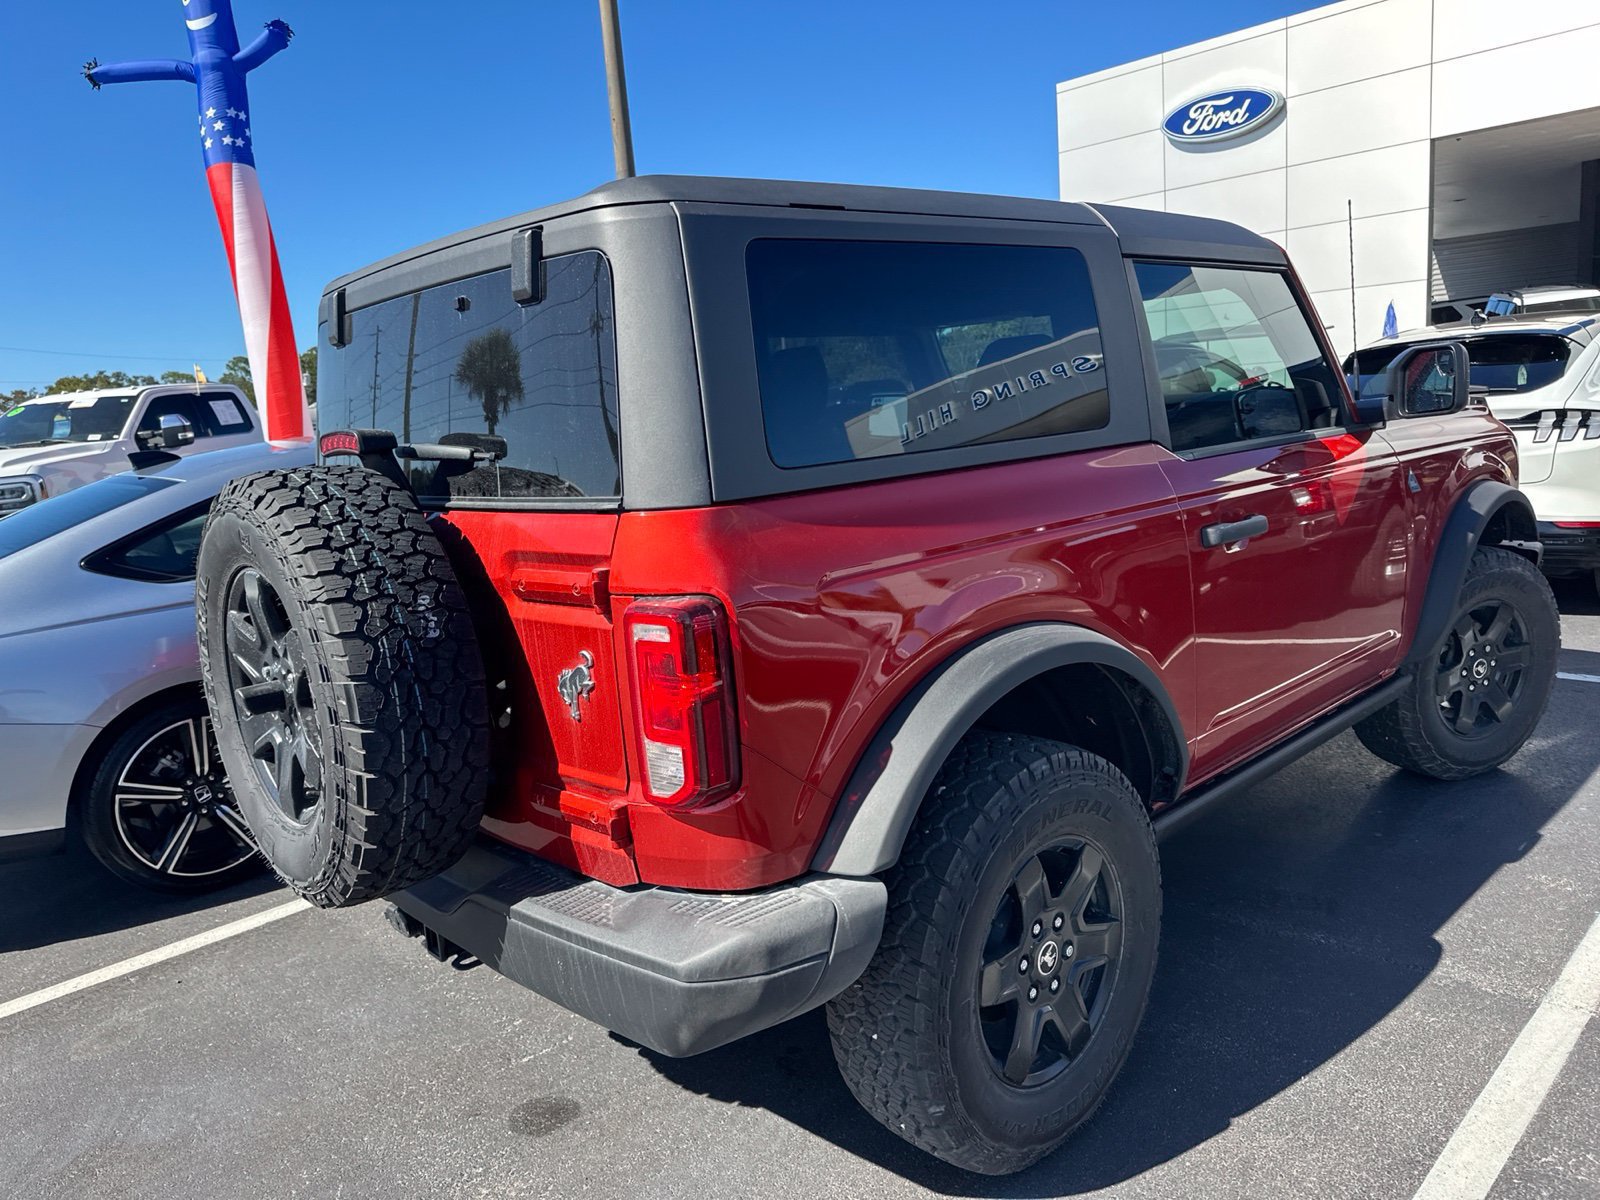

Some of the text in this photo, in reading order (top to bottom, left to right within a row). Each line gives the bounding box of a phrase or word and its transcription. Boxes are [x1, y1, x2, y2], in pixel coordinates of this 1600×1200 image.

[1183, 96, 1251, 135] Ford
[196, 574, 224, 730] GENERAL
[1010, 797, 1113, 863] GENERAL
